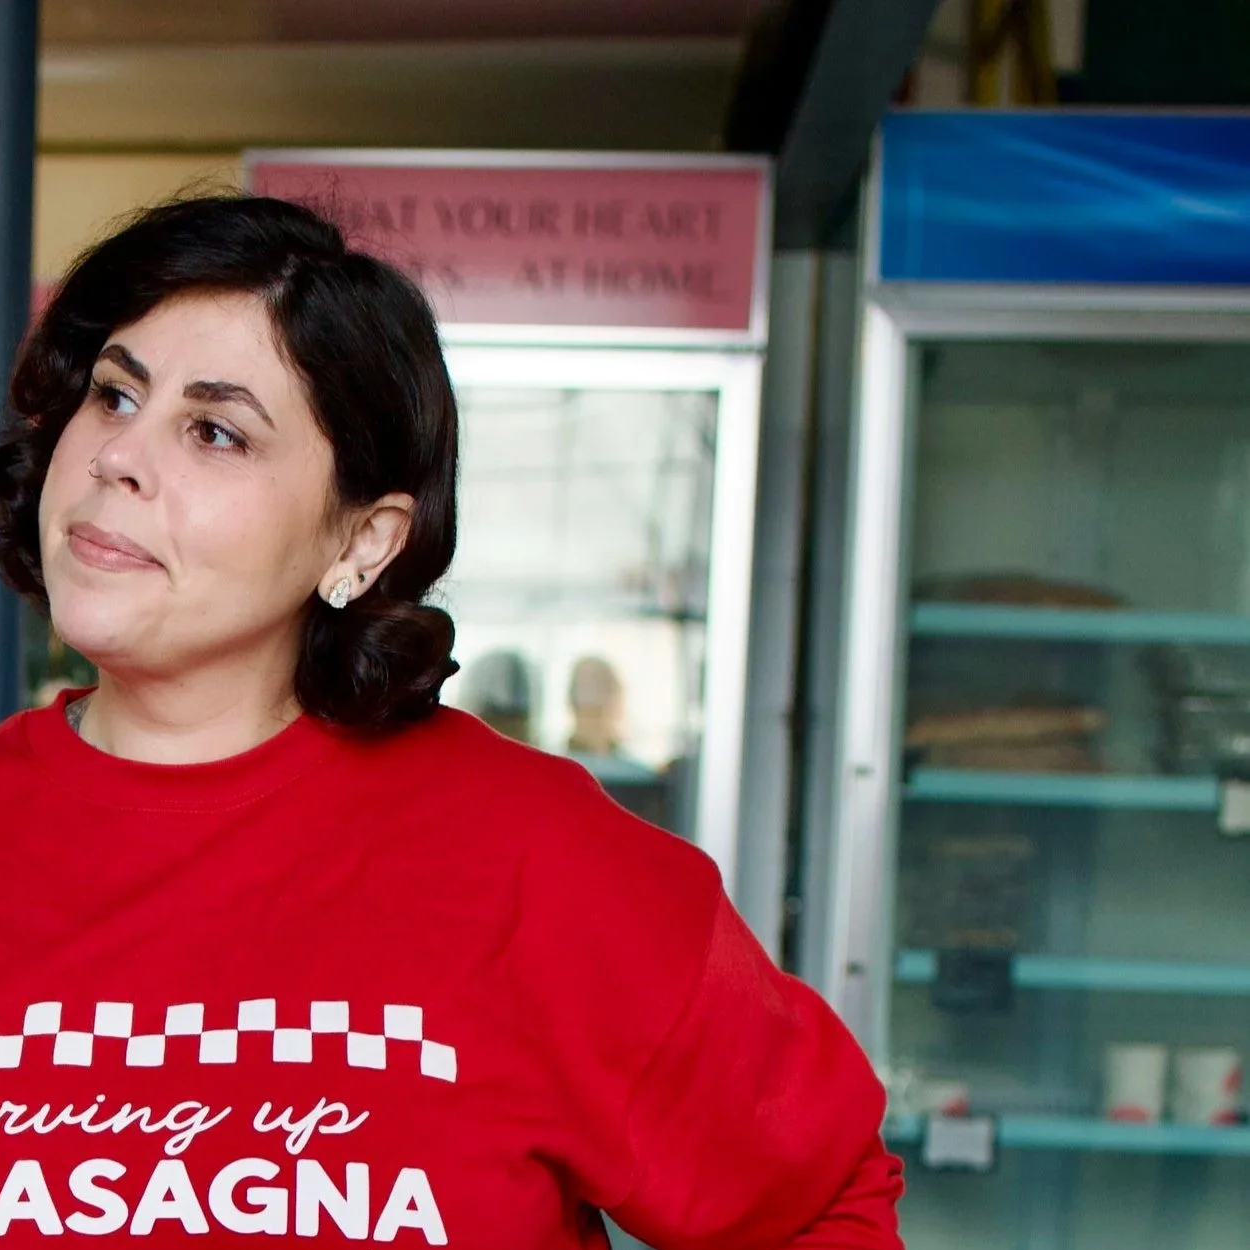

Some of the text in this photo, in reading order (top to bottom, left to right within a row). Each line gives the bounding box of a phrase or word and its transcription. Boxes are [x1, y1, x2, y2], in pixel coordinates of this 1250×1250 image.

[433, 196, 562, 239] YOUR
[572, 198, 722, 242] HEART
[253, 1096, 370, 1155] up
